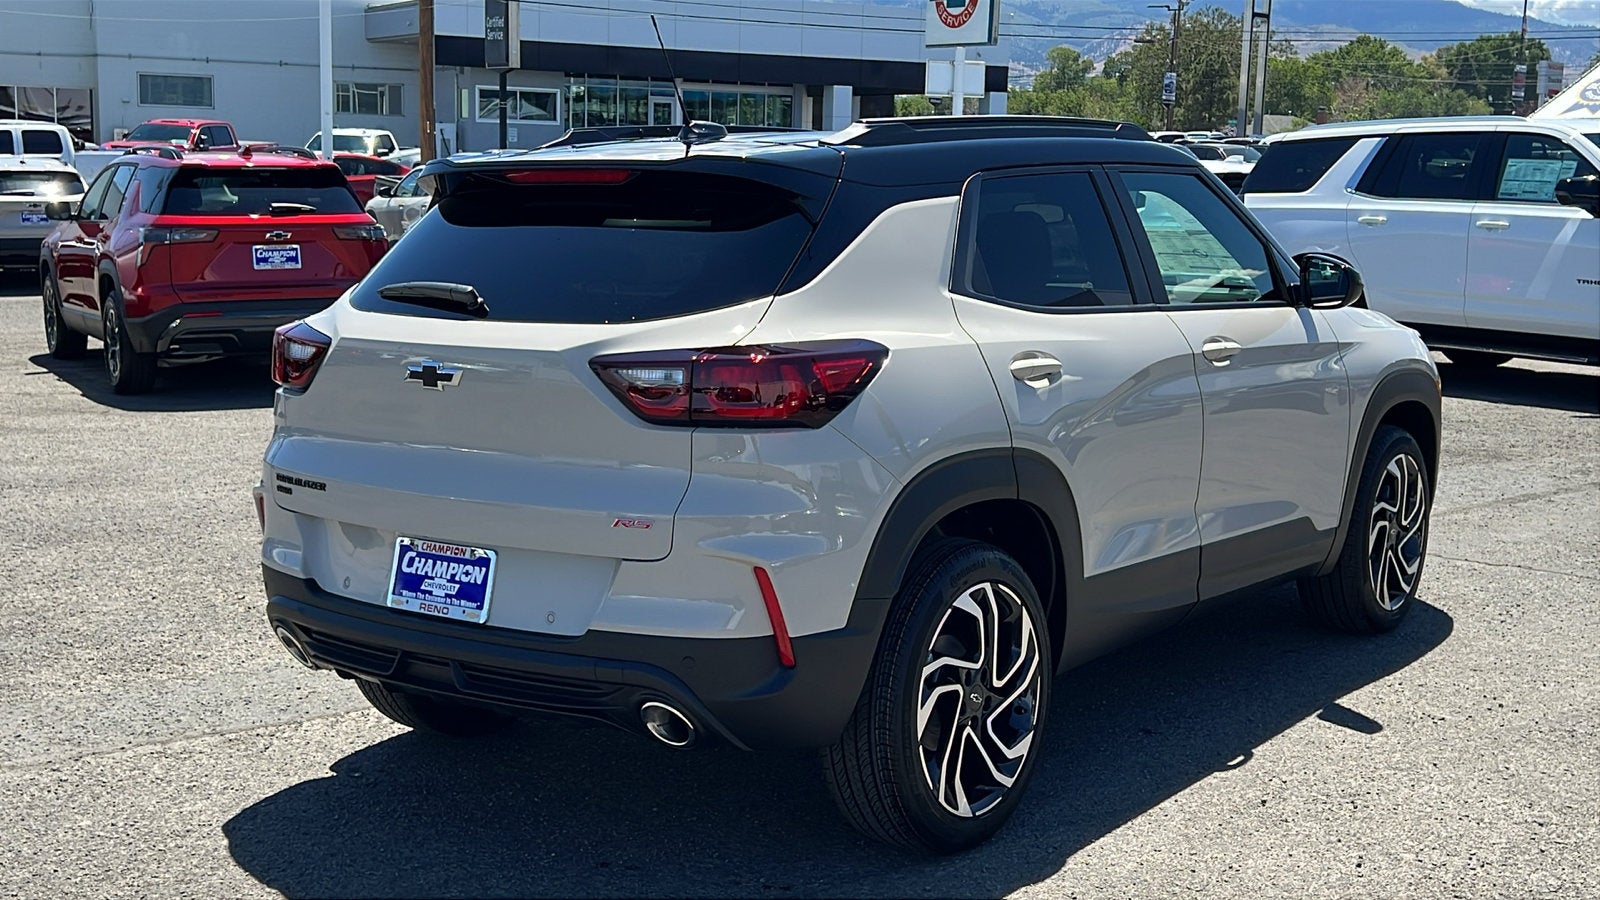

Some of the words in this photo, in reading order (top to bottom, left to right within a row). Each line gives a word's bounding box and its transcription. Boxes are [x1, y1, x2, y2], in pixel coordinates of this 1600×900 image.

[937, 3, 975, 27] SERVICE
[486, 16, 505, 28] Certified
[486, 29, 504, 40] Service
[257, 249, 296, 257] CHAMPION
[276, 473, 327, 491] TRAILBLAZER
[610, 518, 653, 530] RS
[421, 542, 467, 557] CHAMPION
[401, 551, 486, 585] CHAMPION
[423, 580, 456, 593] CHEVROLET
[418, 602, 450, 616] RENO
